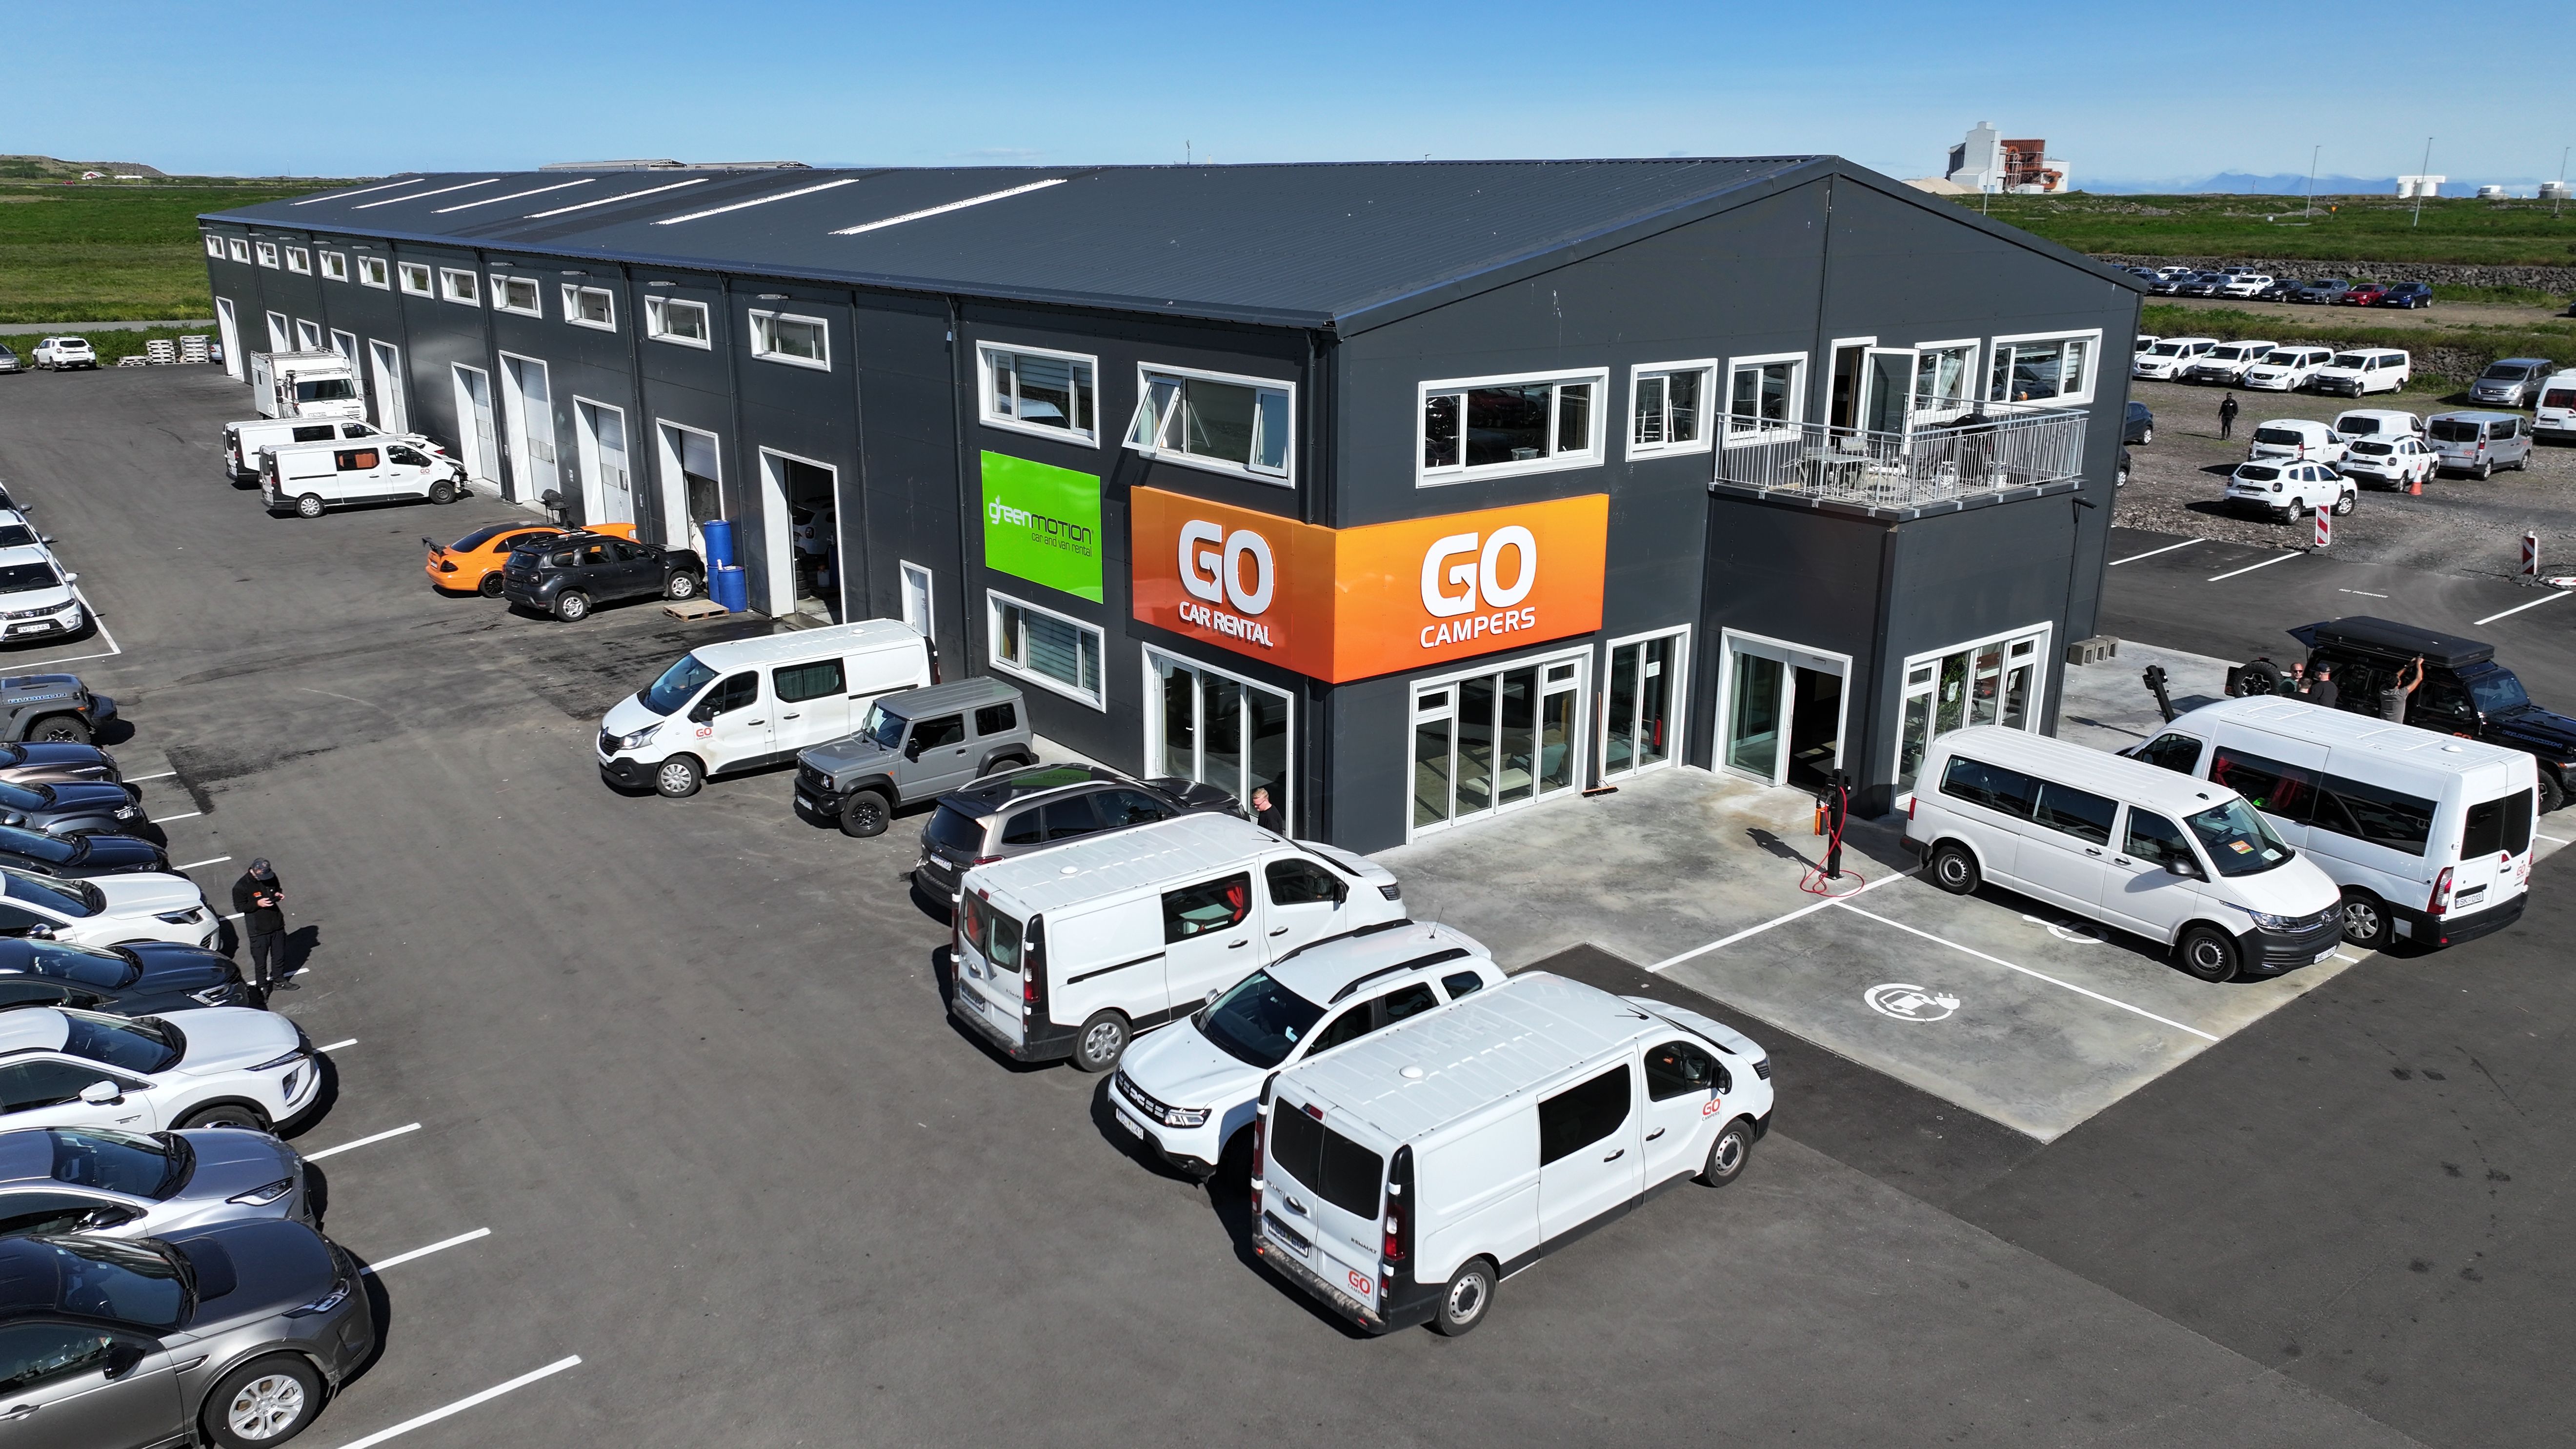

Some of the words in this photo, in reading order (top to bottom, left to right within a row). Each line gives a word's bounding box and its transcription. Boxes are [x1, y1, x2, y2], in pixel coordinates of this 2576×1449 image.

[1031, 532, 1043, 543] car
[1045, 536, 1057, 547] and
[1059, 541, 1070, 551] van
[1072, 543, 1092, 557] rental
[1178, 520, 1274, 615] GO
[1421, 525, 1537, 618] GO
[1179, 602, 1210, 627] CAR
[1214, 610, 1273, 647] RENTAL
[1420, 606, 1535, 648] CAMPERS
[8, 692, 67, 704] RUBICON
[696, 727, 712, 737] GO
[2501, 730, 2563, 748] RUBICON
[1703, 1098, 1721, 1116] GO
[1351, 1238, 1377, 1255] RENAULT
[1347, 1283, 1371, 1302] CAMPERS
[1348, 1270, 1371, 1295] GO
